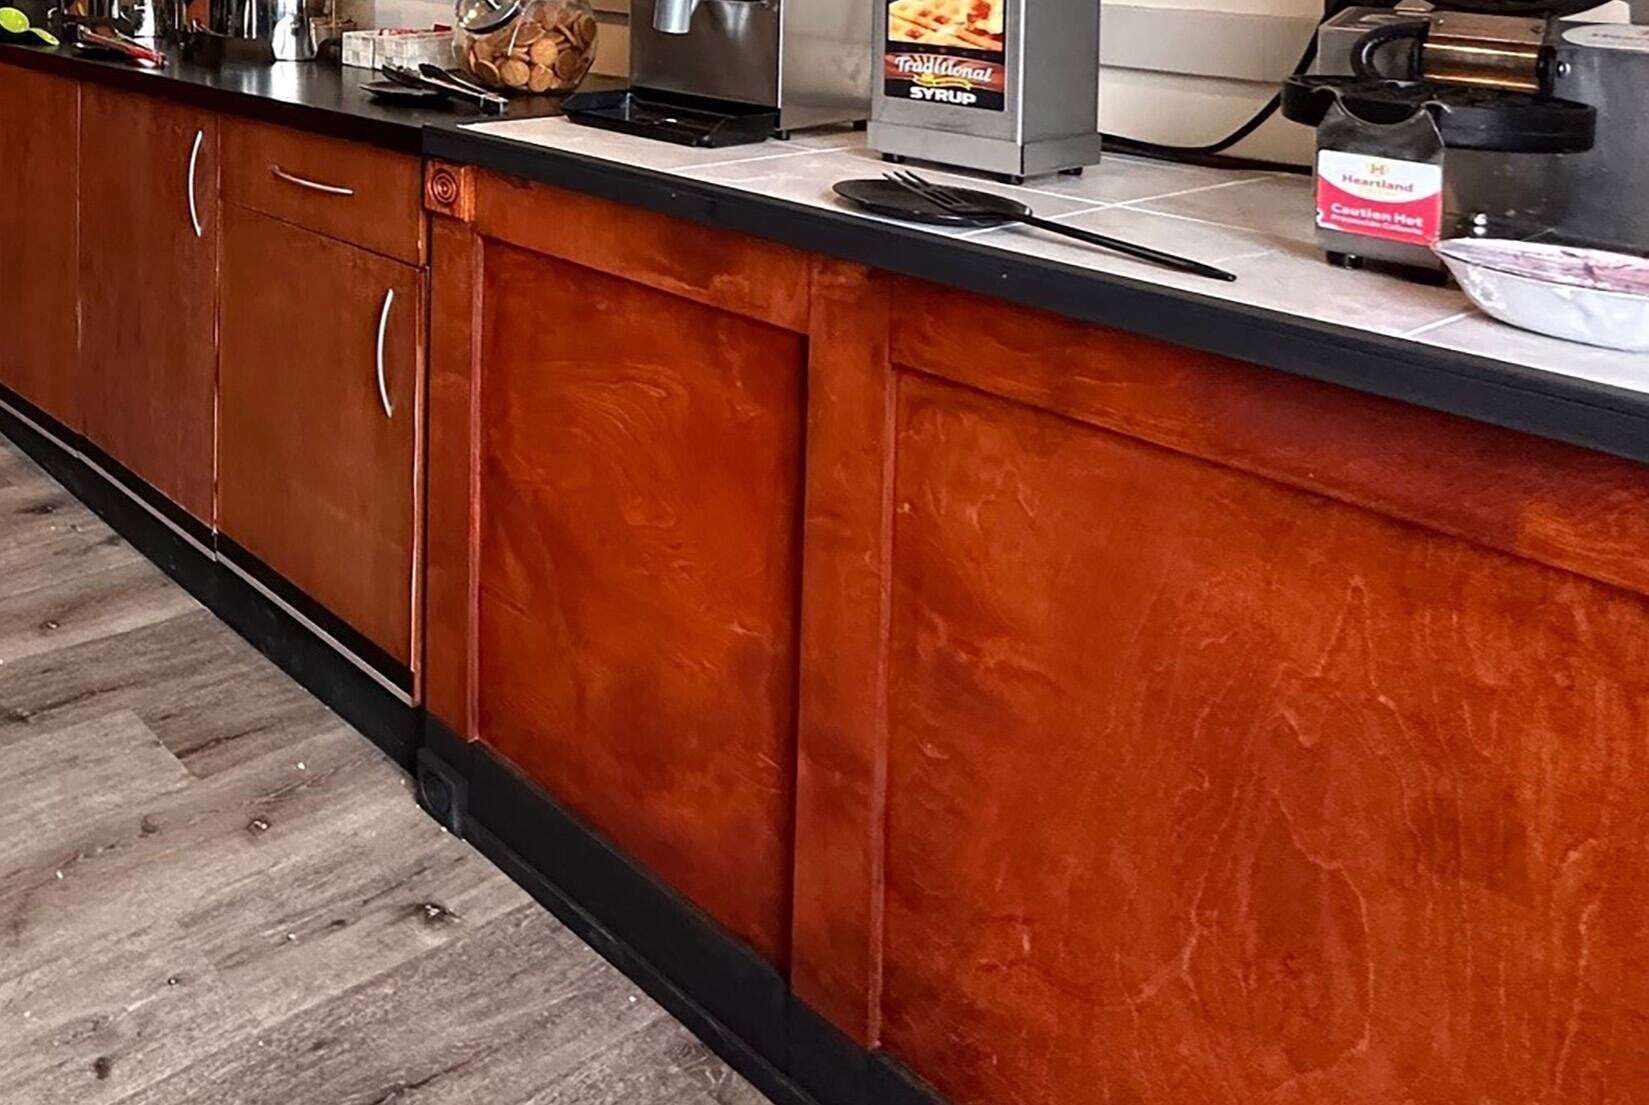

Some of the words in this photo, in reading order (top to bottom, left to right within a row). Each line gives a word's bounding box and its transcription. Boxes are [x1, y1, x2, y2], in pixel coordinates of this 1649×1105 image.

[894, 56, 993, 83] Traditional
[910, 86, 977, 105] SYRUP
[1341, 173, 1415, 193] Heartland
[1330, 202, 1392, 223] Caution
[1393, 212, 1424, 227] Hot
